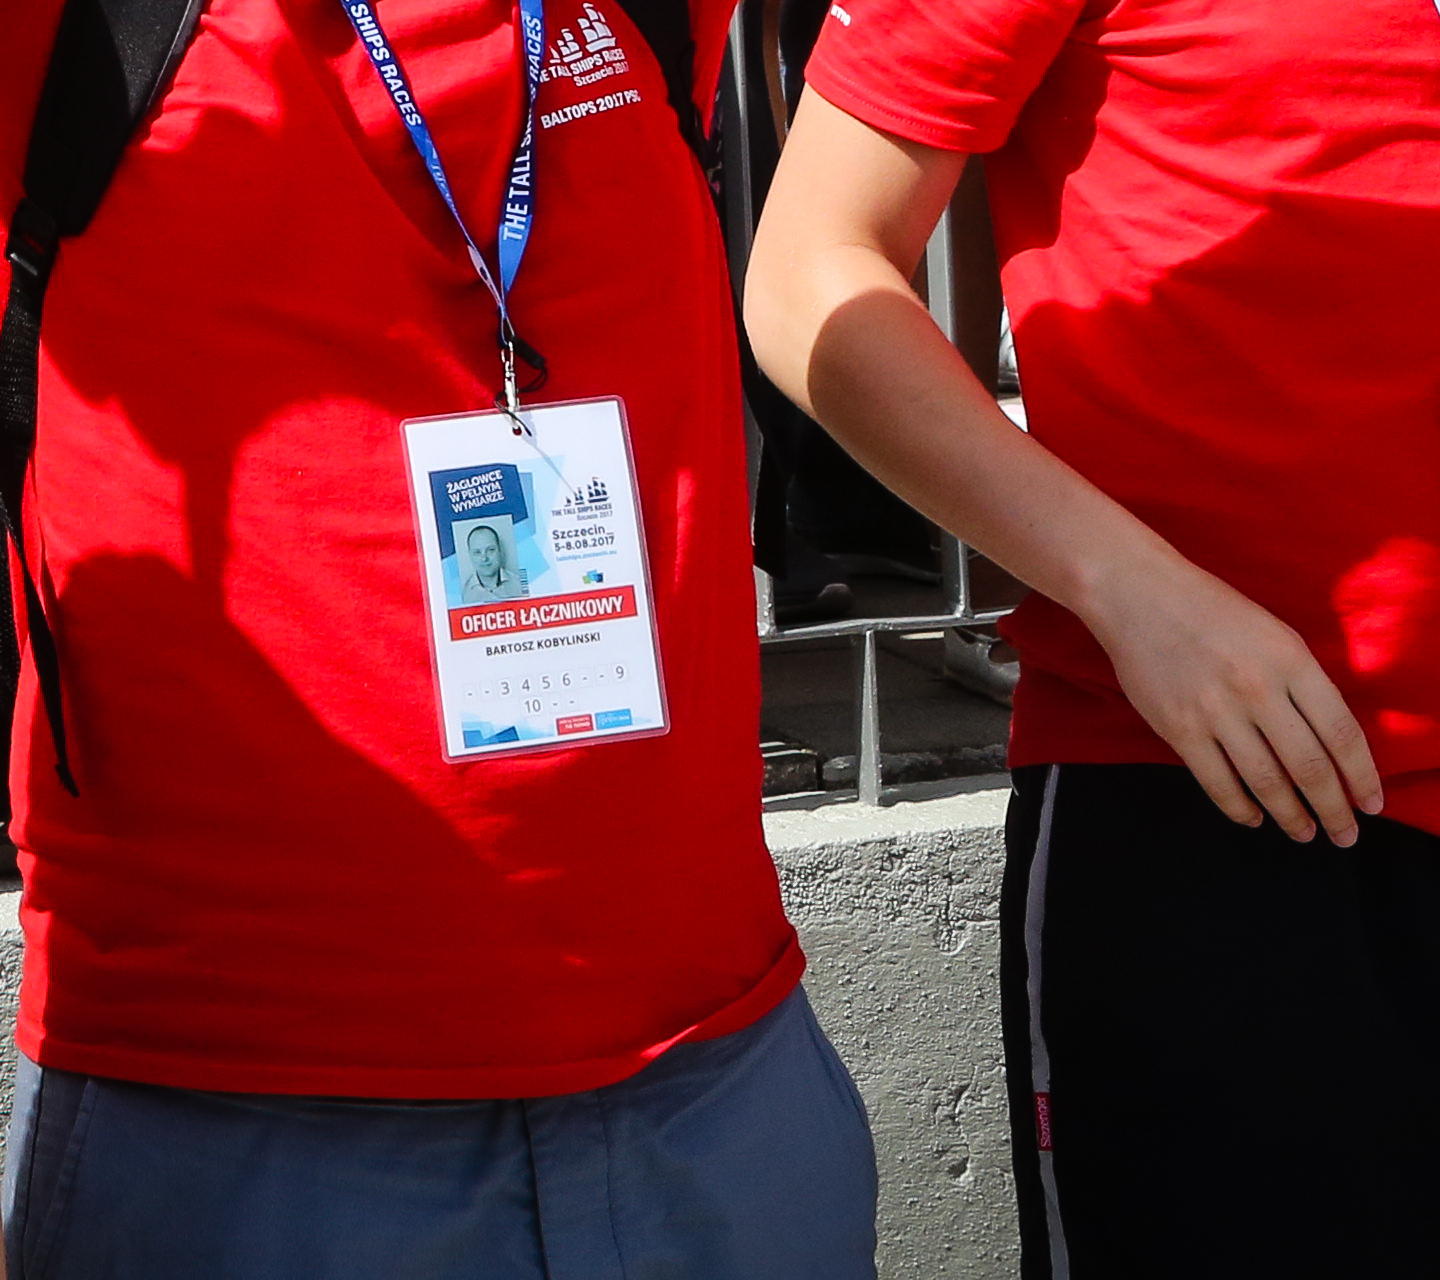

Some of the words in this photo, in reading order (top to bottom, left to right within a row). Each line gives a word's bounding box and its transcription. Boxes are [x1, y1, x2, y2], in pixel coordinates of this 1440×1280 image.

[528, 15, 543, 83] RACES
[350, 2, 391, 64] SHIPS
[380, 63, 422, 128] RACES
[570, 53, 604, 76] SHIPS
[540, 100, 598, 129] BALTOPS
[596, 91, 625, 112] 2017
[508, 146, 531, 199] TALL
[503, 197, 526, 241] THE
[449, 491, 461, 504] W
[451, 491, 505, 514] WYMIARZE
[554, 535, 616, 553] 5-8.08.2017
[460, 608, 517, 635] OFICER
[519, 594, 624, 628] ŁĄCZNIKOWY
[485, 640, 535, 657] BARTOSZ
[500, 681, 511, 695] 3
[521, 678, 531, 692] 4
[541, 675, 551, 689] 5
[561, 672, 572, 687] 6
[615, 665, 625, 679] 9
[524, 698, 542, 713] 10
